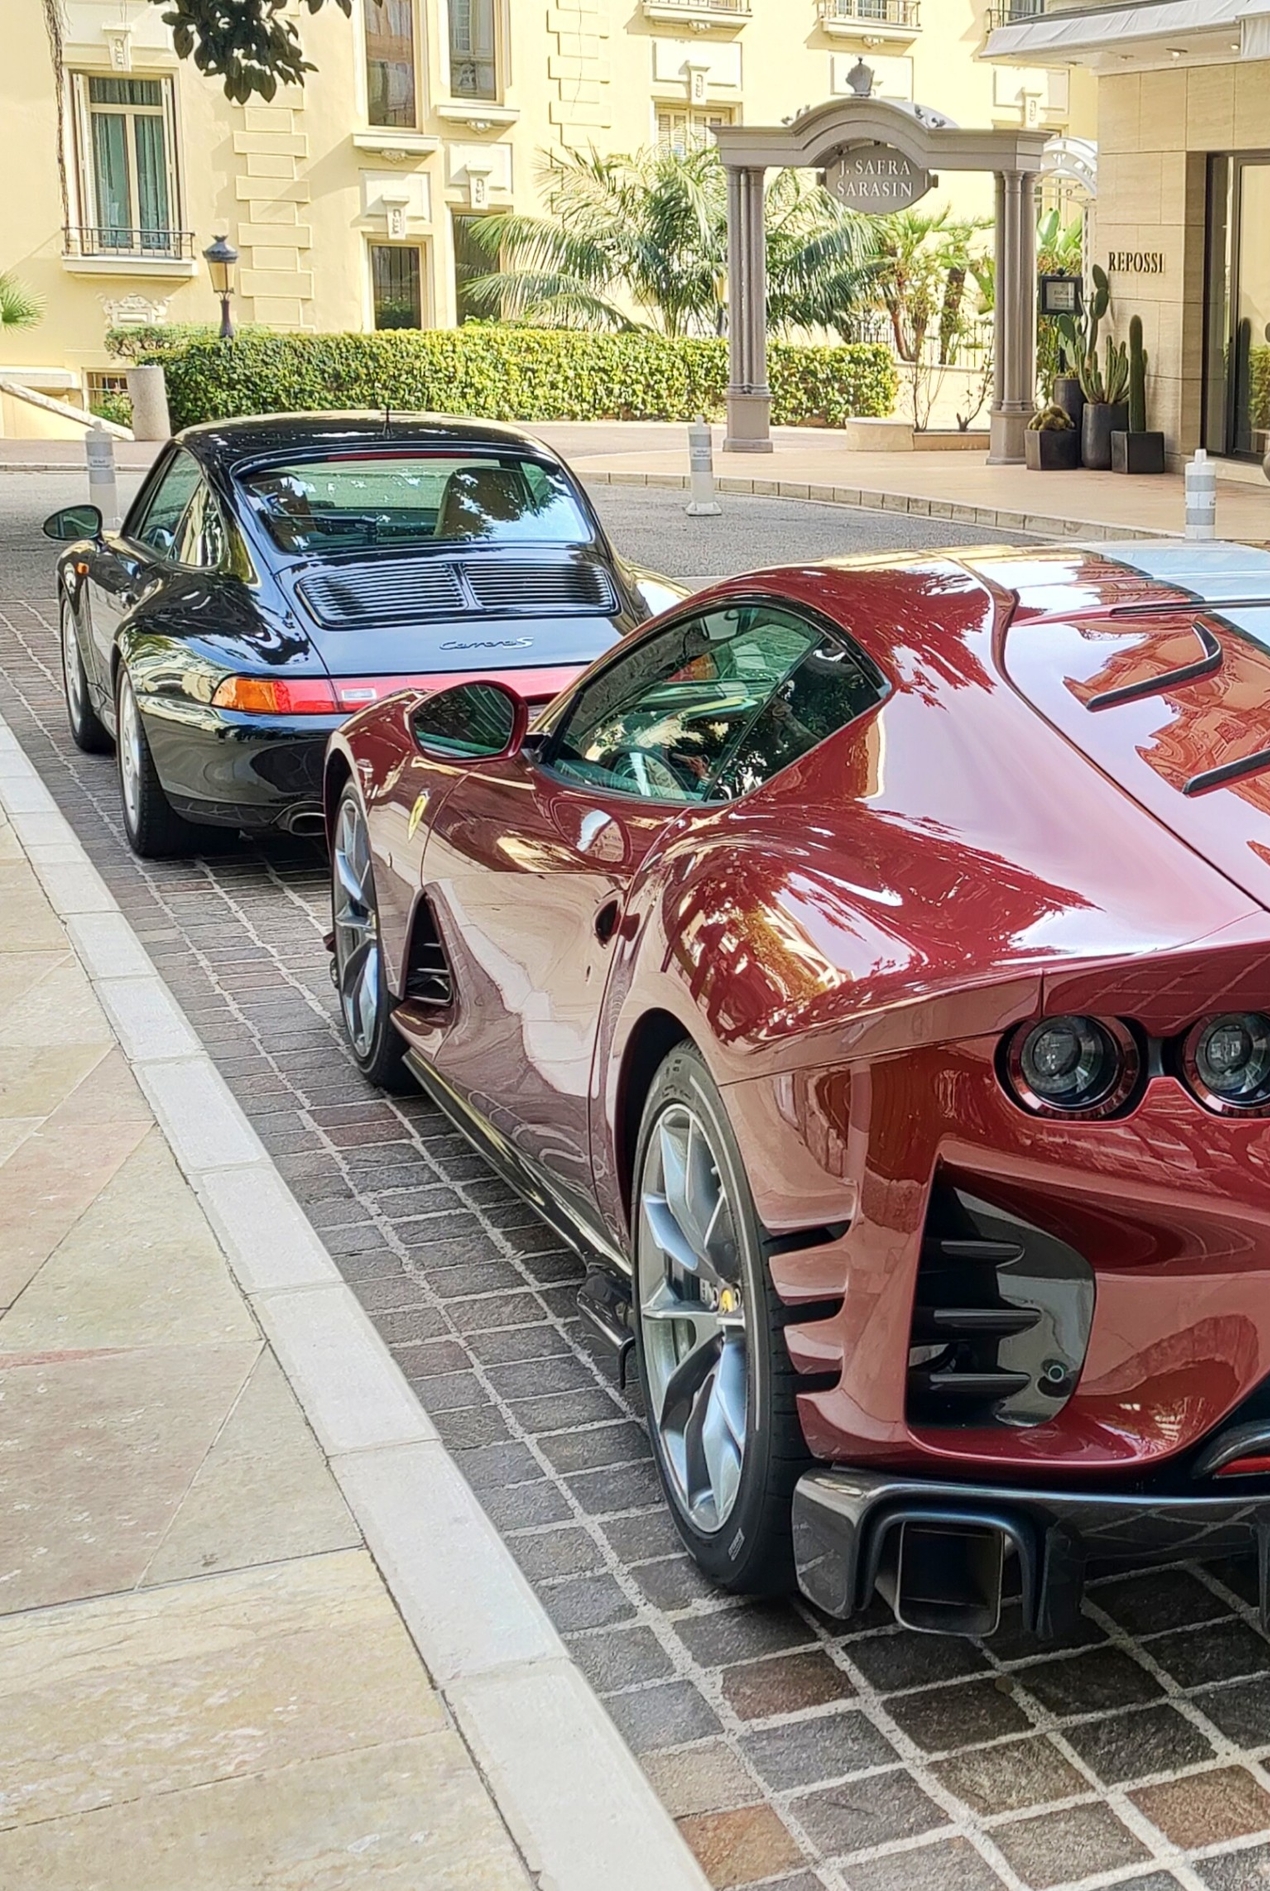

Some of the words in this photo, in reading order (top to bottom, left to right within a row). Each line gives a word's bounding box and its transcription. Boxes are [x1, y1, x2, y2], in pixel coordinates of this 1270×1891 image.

[839, 160, 850, 178] J.
[855, 160, 911, 176] SAFRA
[837, 181, 913, 198] SARASIN
[1108, 251, 1164, 274] REPOSSI
